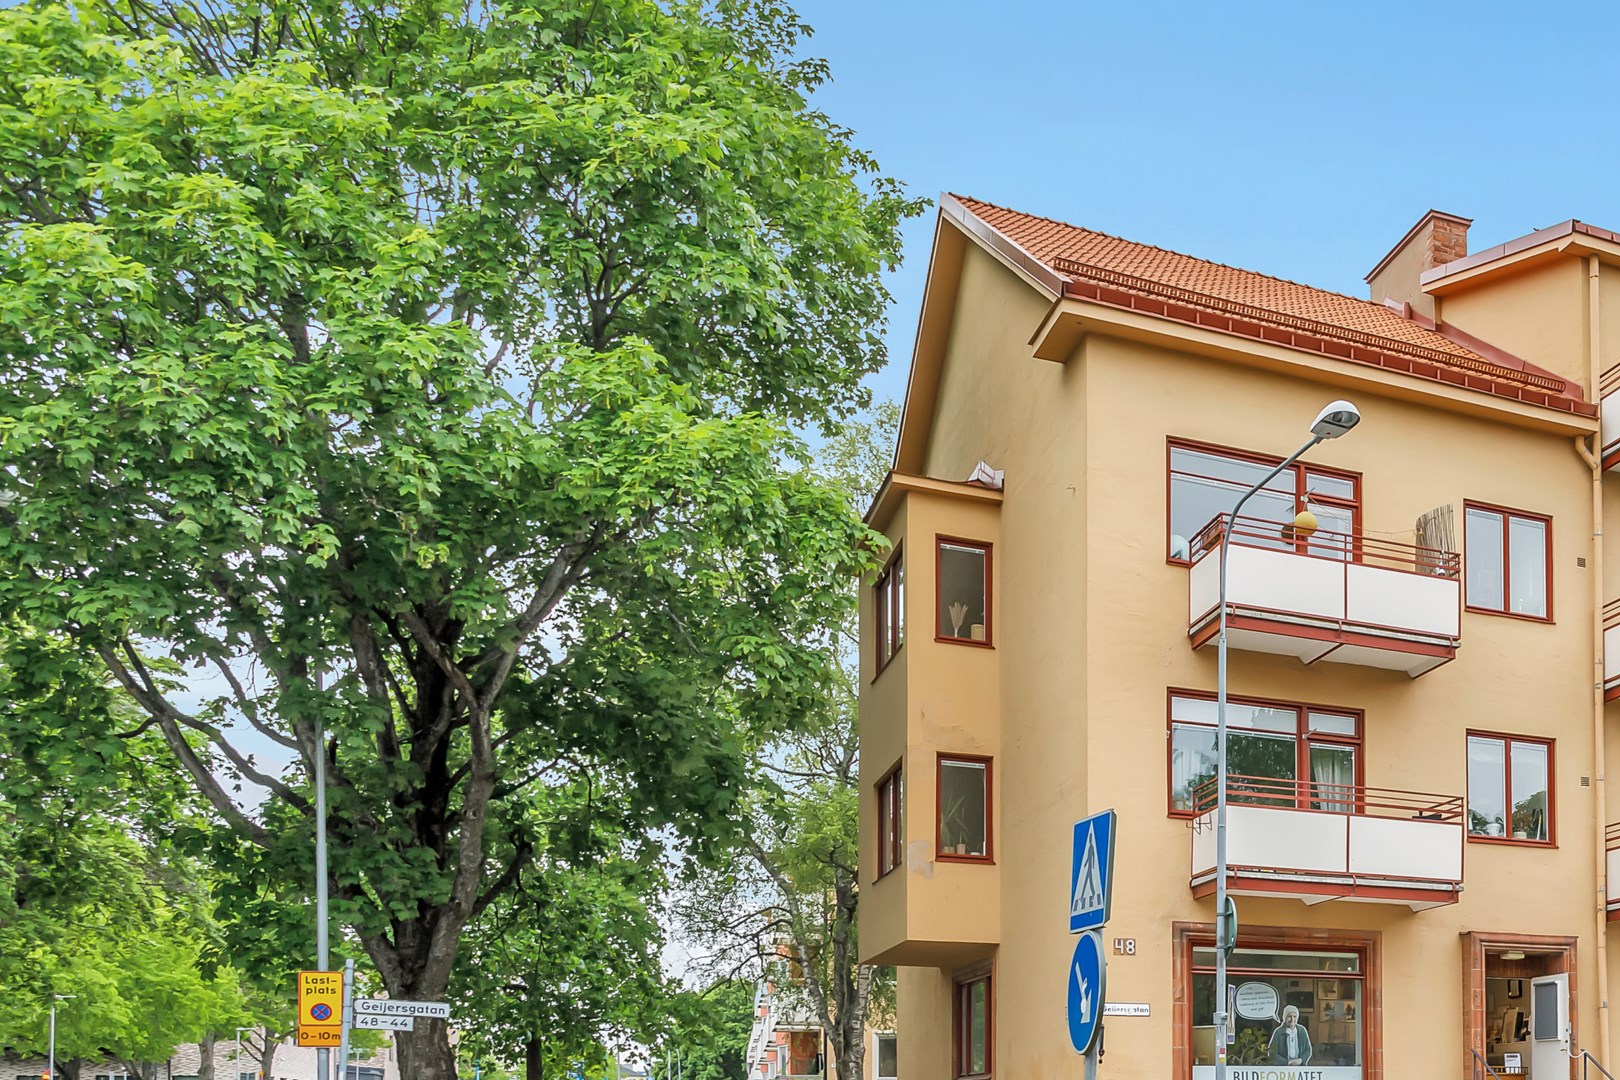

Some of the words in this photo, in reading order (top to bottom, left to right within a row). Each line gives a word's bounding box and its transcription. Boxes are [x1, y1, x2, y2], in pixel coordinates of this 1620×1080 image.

[1114, 939, 1135, 954] 48
[305, 976, 338, 984] Last-
[305, 986, 337, 995] plats
[361, 1001, 446, 1015] Geijersgatan
[360, 1017, 408, 1028] 48-44
